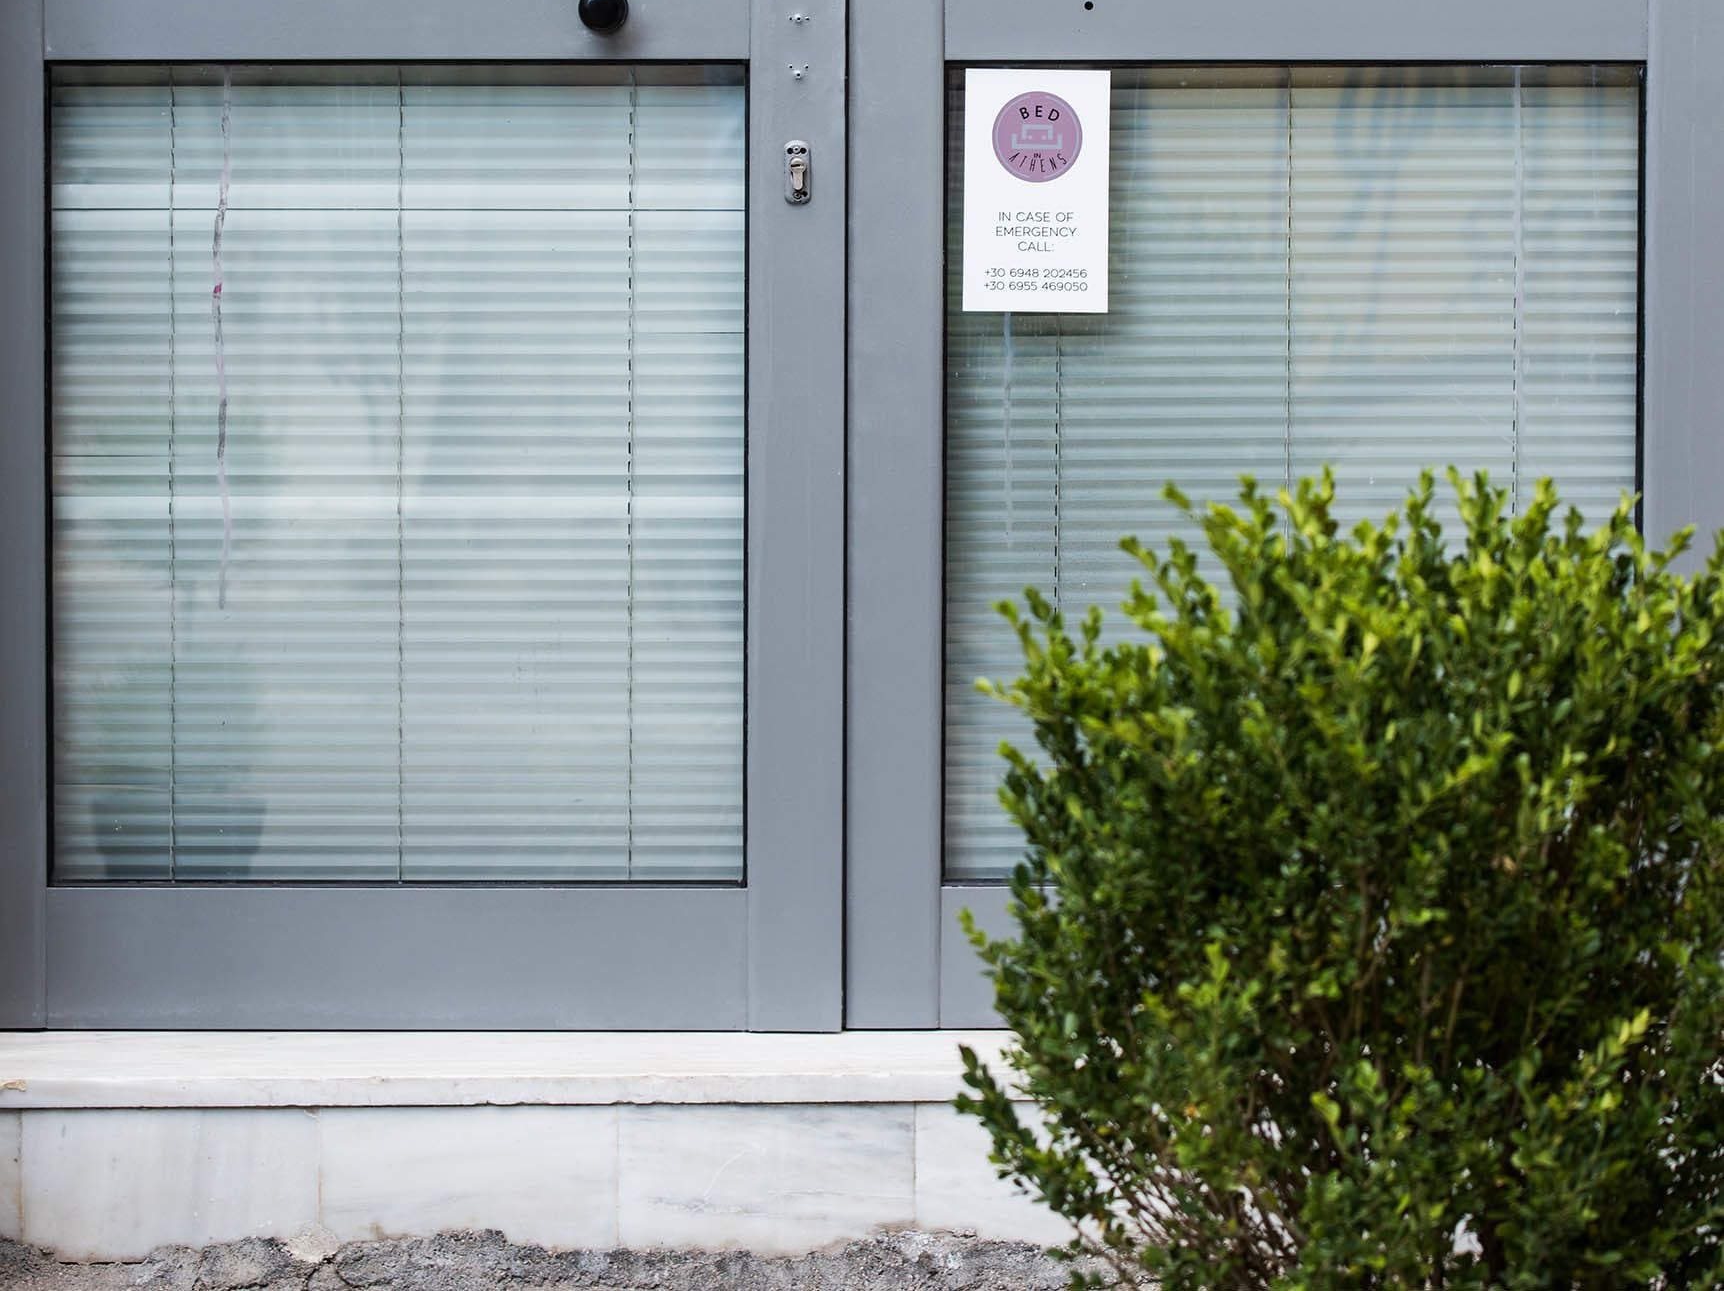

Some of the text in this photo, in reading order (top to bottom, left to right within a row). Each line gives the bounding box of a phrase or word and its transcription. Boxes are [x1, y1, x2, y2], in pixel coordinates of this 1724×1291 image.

[1018, 105, 1060, 121] BED
[1007, 151, 1068, 173] ATHENS
[998, 211, 1075, 222] IN CASE OF
[995, 226, 1077, 237] EMERGENCY
[984, 268, 1088, 279] +30 6948 202456
[983, 281, 1089, 292] +30 6955 469050
